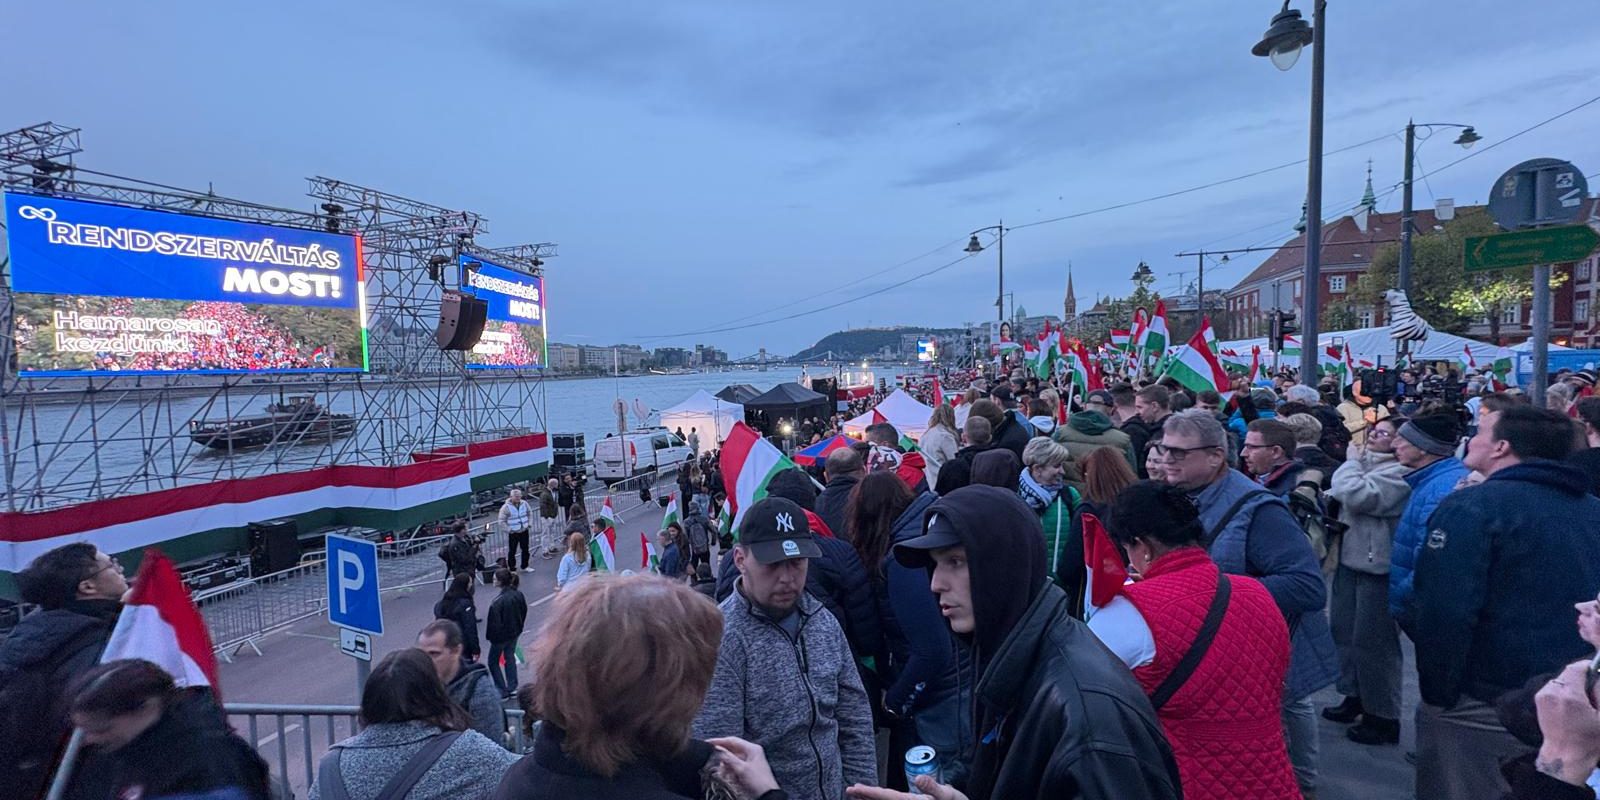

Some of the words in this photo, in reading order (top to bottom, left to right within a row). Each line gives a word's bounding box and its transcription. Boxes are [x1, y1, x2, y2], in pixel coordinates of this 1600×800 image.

[48, 221, 340, 270] RENDSZERVÁLTÁS
[223, 267, 341, 298] MOST!
[54, 311, 221, 334] Hamarosan
[55, 332, 190, 356] kezdünk!
[775, 512, 795, 532] NY
[338, 549, 365, 614] P
